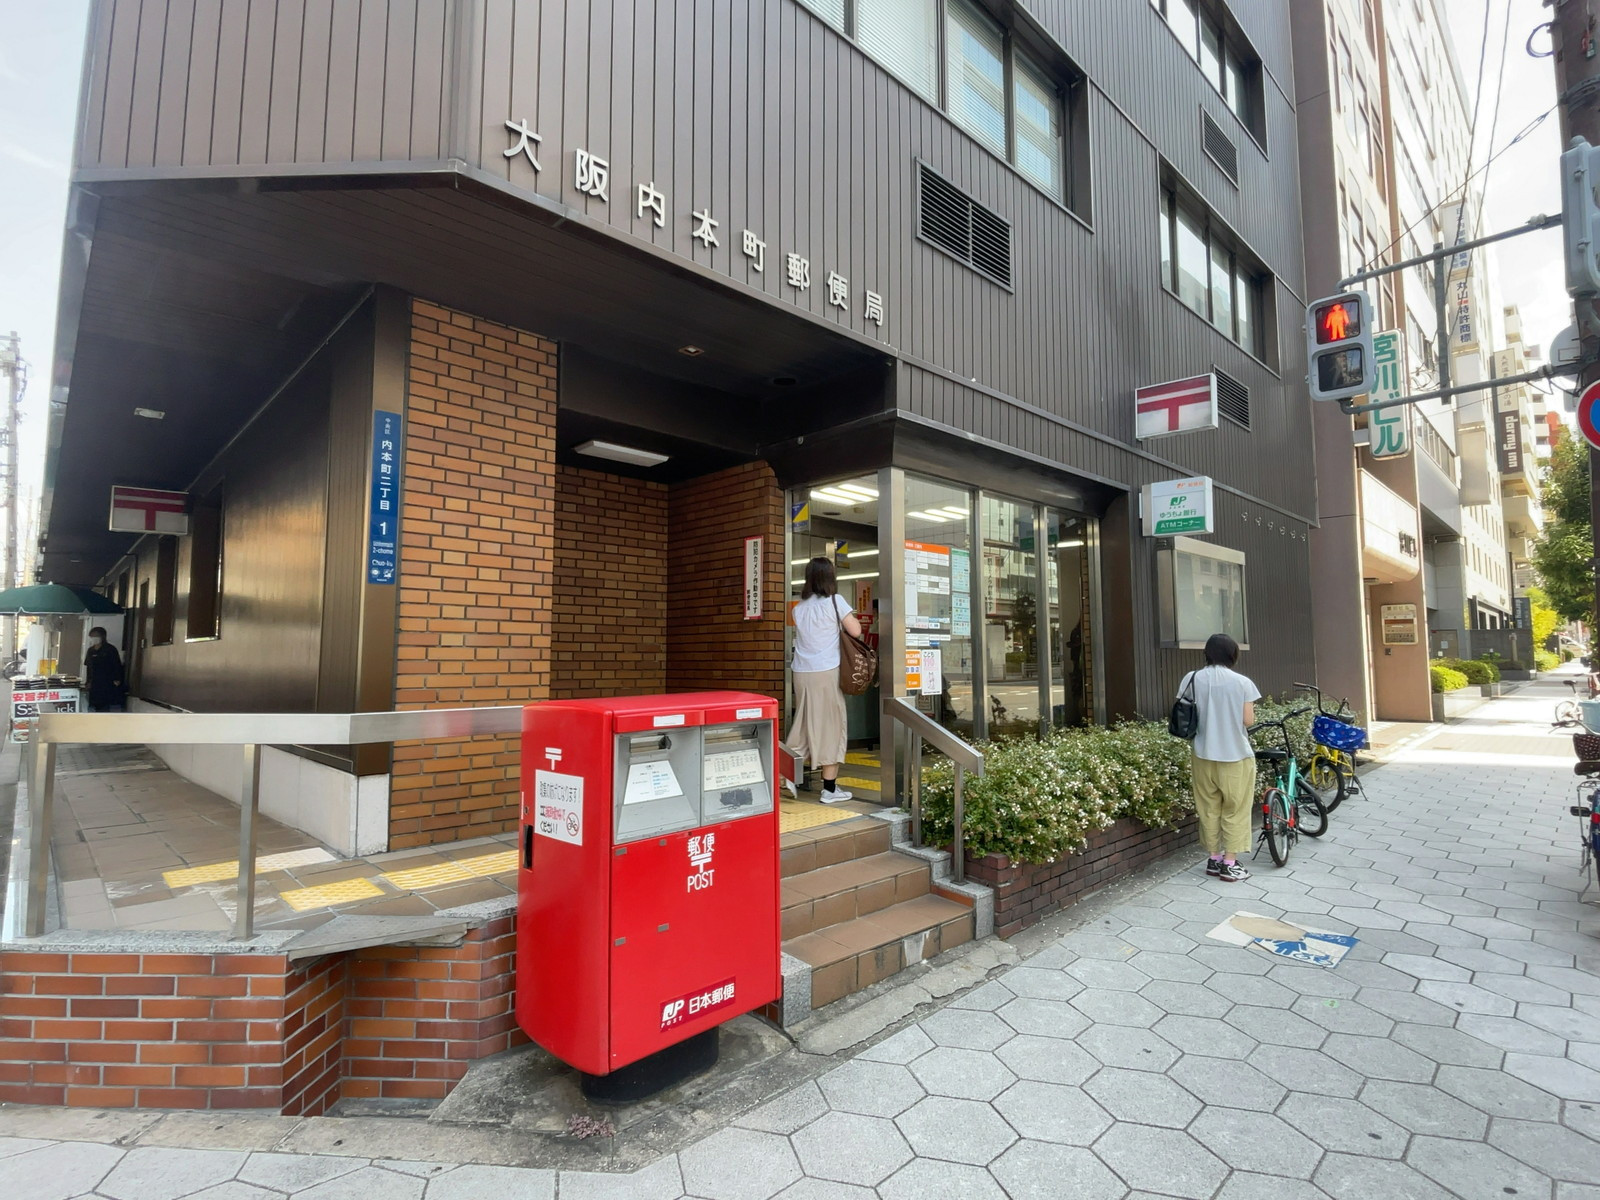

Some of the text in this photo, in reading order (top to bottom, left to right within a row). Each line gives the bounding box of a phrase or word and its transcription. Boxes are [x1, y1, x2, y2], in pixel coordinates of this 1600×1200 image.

[503, 117, 884, 328] 大阪内本町郵便局
[1371, 334, 1404, 455] 宮川ビル
[380, 439, 393, 511] 内本町二丁目
[1160, 509, 1197, 519] ゆうちょ銀行
[1160, 520, 1201, 529] ATMコーナー
[380, 521, 386, 536] 1
[687, 832, 715, 858] 郵便
[687, 869, 715, 893] POST
[689, 982, 735, 1015] 日本郵便
[661, 1015, 683, 1029] POST
